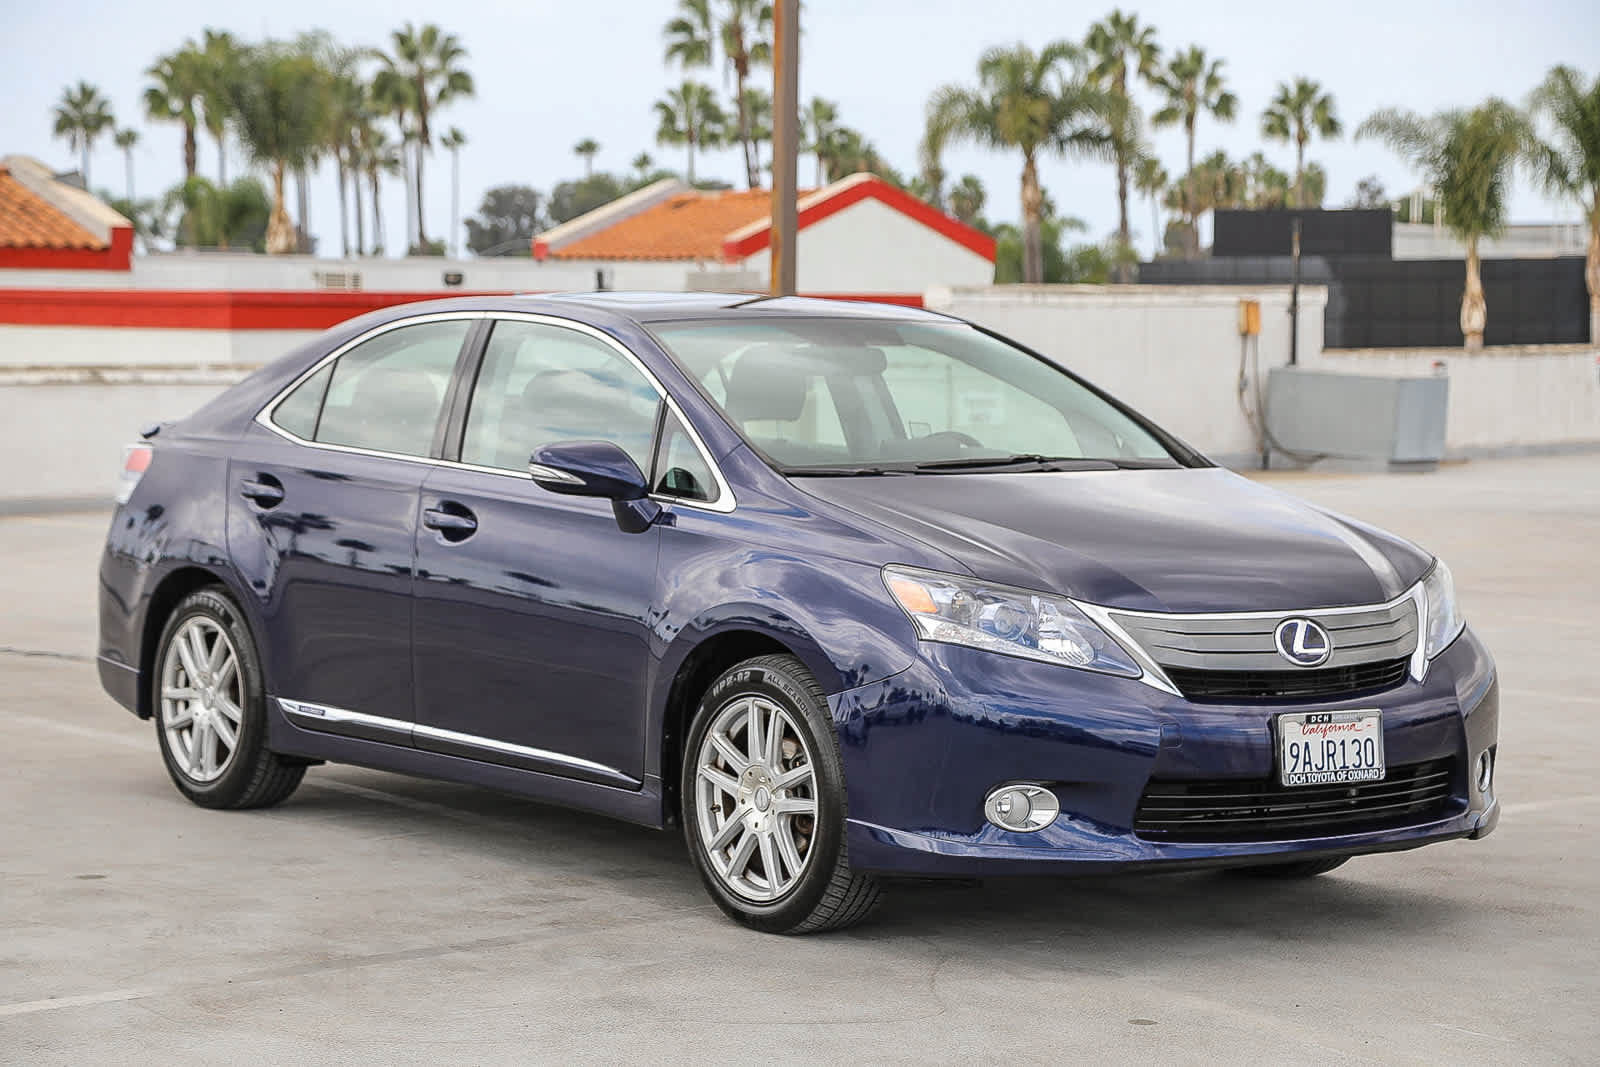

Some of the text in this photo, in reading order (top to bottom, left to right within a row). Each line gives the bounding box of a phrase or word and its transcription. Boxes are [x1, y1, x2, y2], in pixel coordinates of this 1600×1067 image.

[767, 673, 812, 717] ALL SEASON
[1310, 714, 1330, 723] DCH
[1302, 722, 1363, 738] California
[1289, 737, 1375, 772] 9AJR130
[1289, 768, 1380, 785] DCH TOYOTA OF OXNARD
